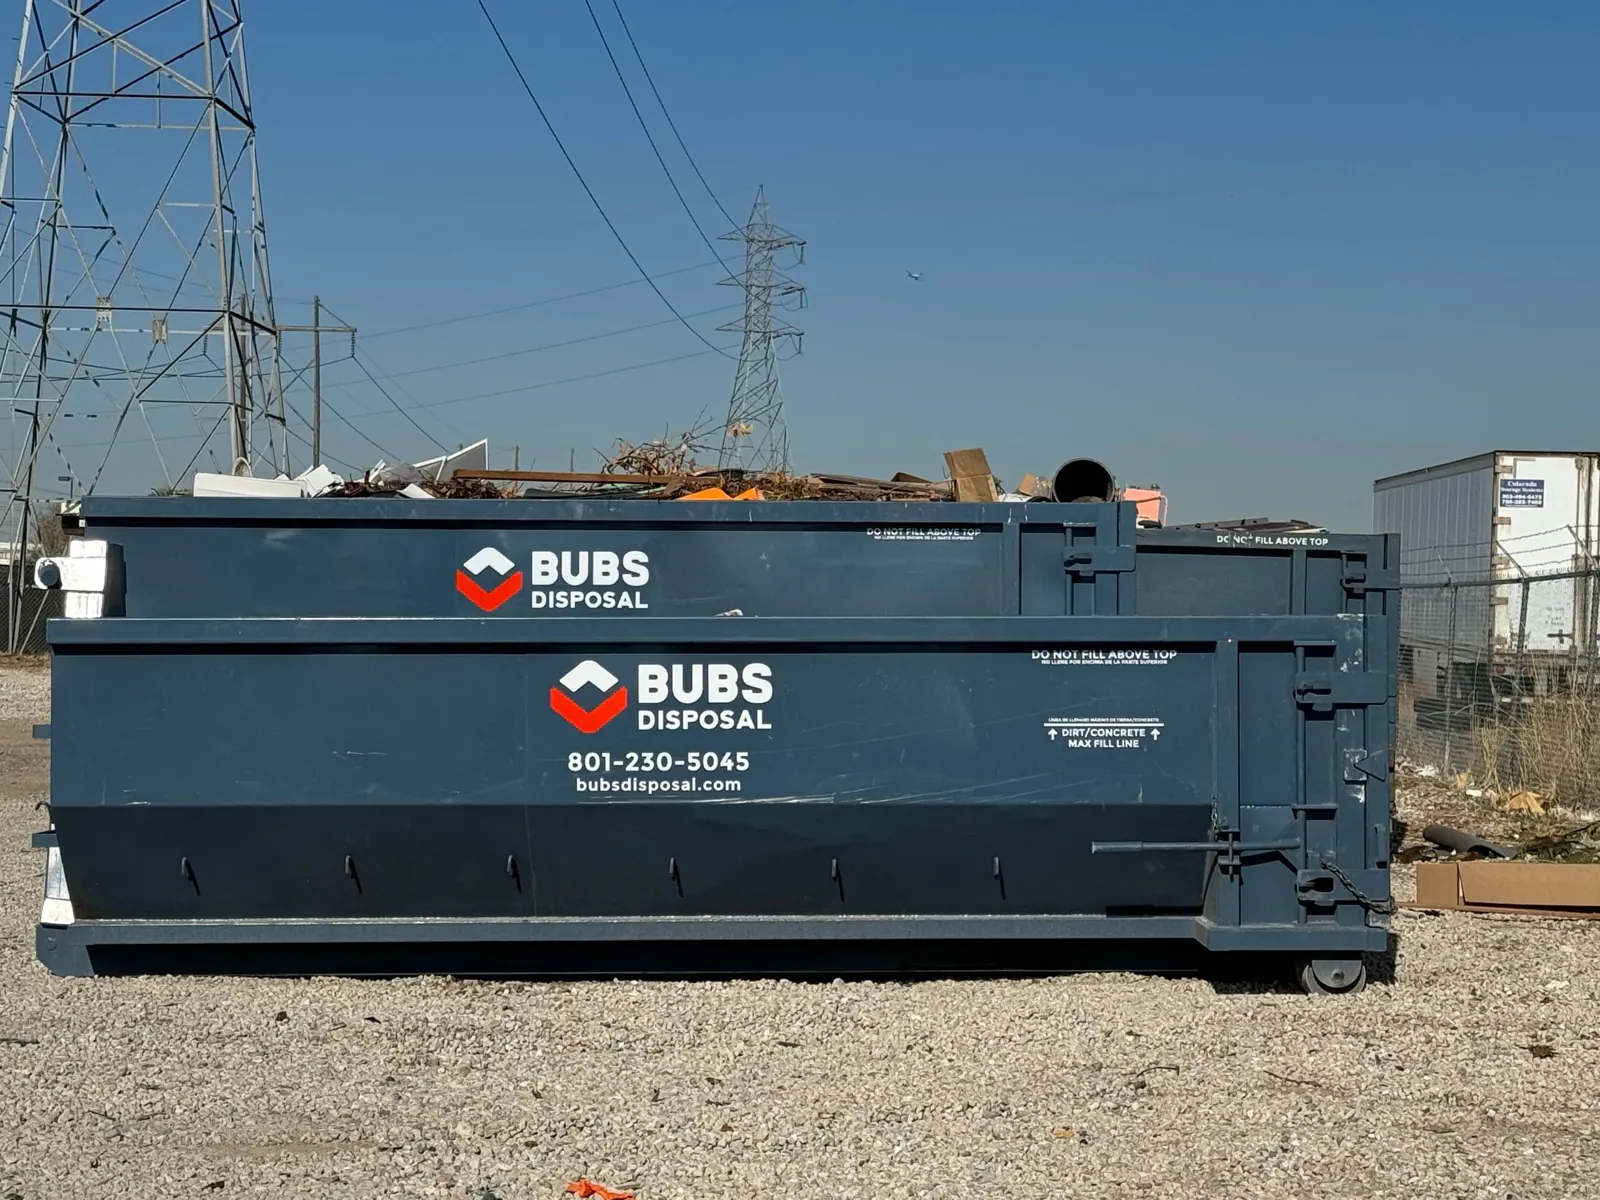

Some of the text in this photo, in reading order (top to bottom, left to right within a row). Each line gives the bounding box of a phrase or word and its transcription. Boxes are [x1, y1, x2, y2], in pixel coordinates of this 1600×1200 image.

[867, 528, 881, 536] DO
[884, 528, 904, 536] NOT
[906, 528, 925, 536] FILL
[927, 528, 960, 536] ABOVE
[1255, 536, 1273, 545] FILL
[1275, 537, 1307, 545] ABOVE
[1310, 538, 1329, 546] TOP
[532, 551, 650, 586] BUBS
[532, 591, 648, 609] DISPOSAL
[1032, 650, 1177, 659] DO NOT FILL ABOVE TOP
[638, 662, 773, 704] BUBS
[638, 710, 773, 730] DISPOSAL
[1062, 728, 1146, 738] DIRT/CONCRETE
[1068, 739, 1139, 748] MAX FILL LINE
[568, 752, 750, 772] 801-230-5045
[576, 777, 741, 795] bubsdisposal.com
